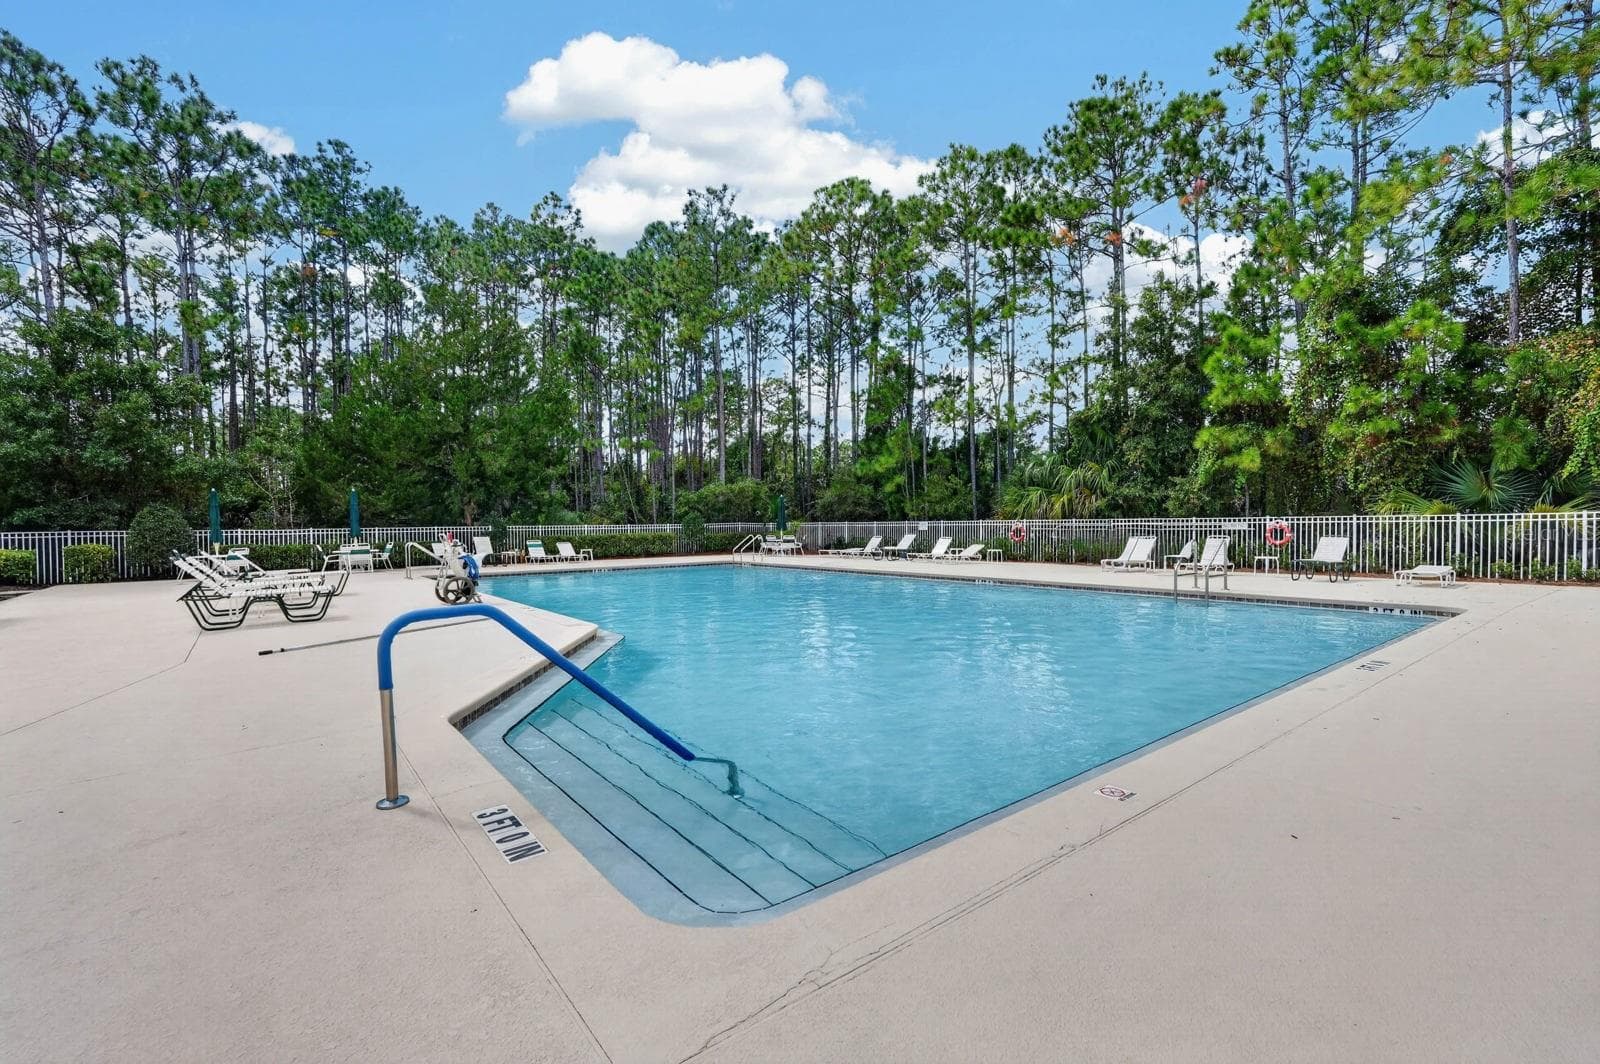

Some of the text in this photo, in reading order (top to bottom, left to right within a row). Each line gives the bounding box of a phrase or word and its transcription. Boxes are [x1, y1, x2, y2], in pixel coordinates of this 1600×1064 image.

[476, 808, 509, 819] 3
[482, 815, 523, 833] FT
[502, 841, 546, 862] IN
